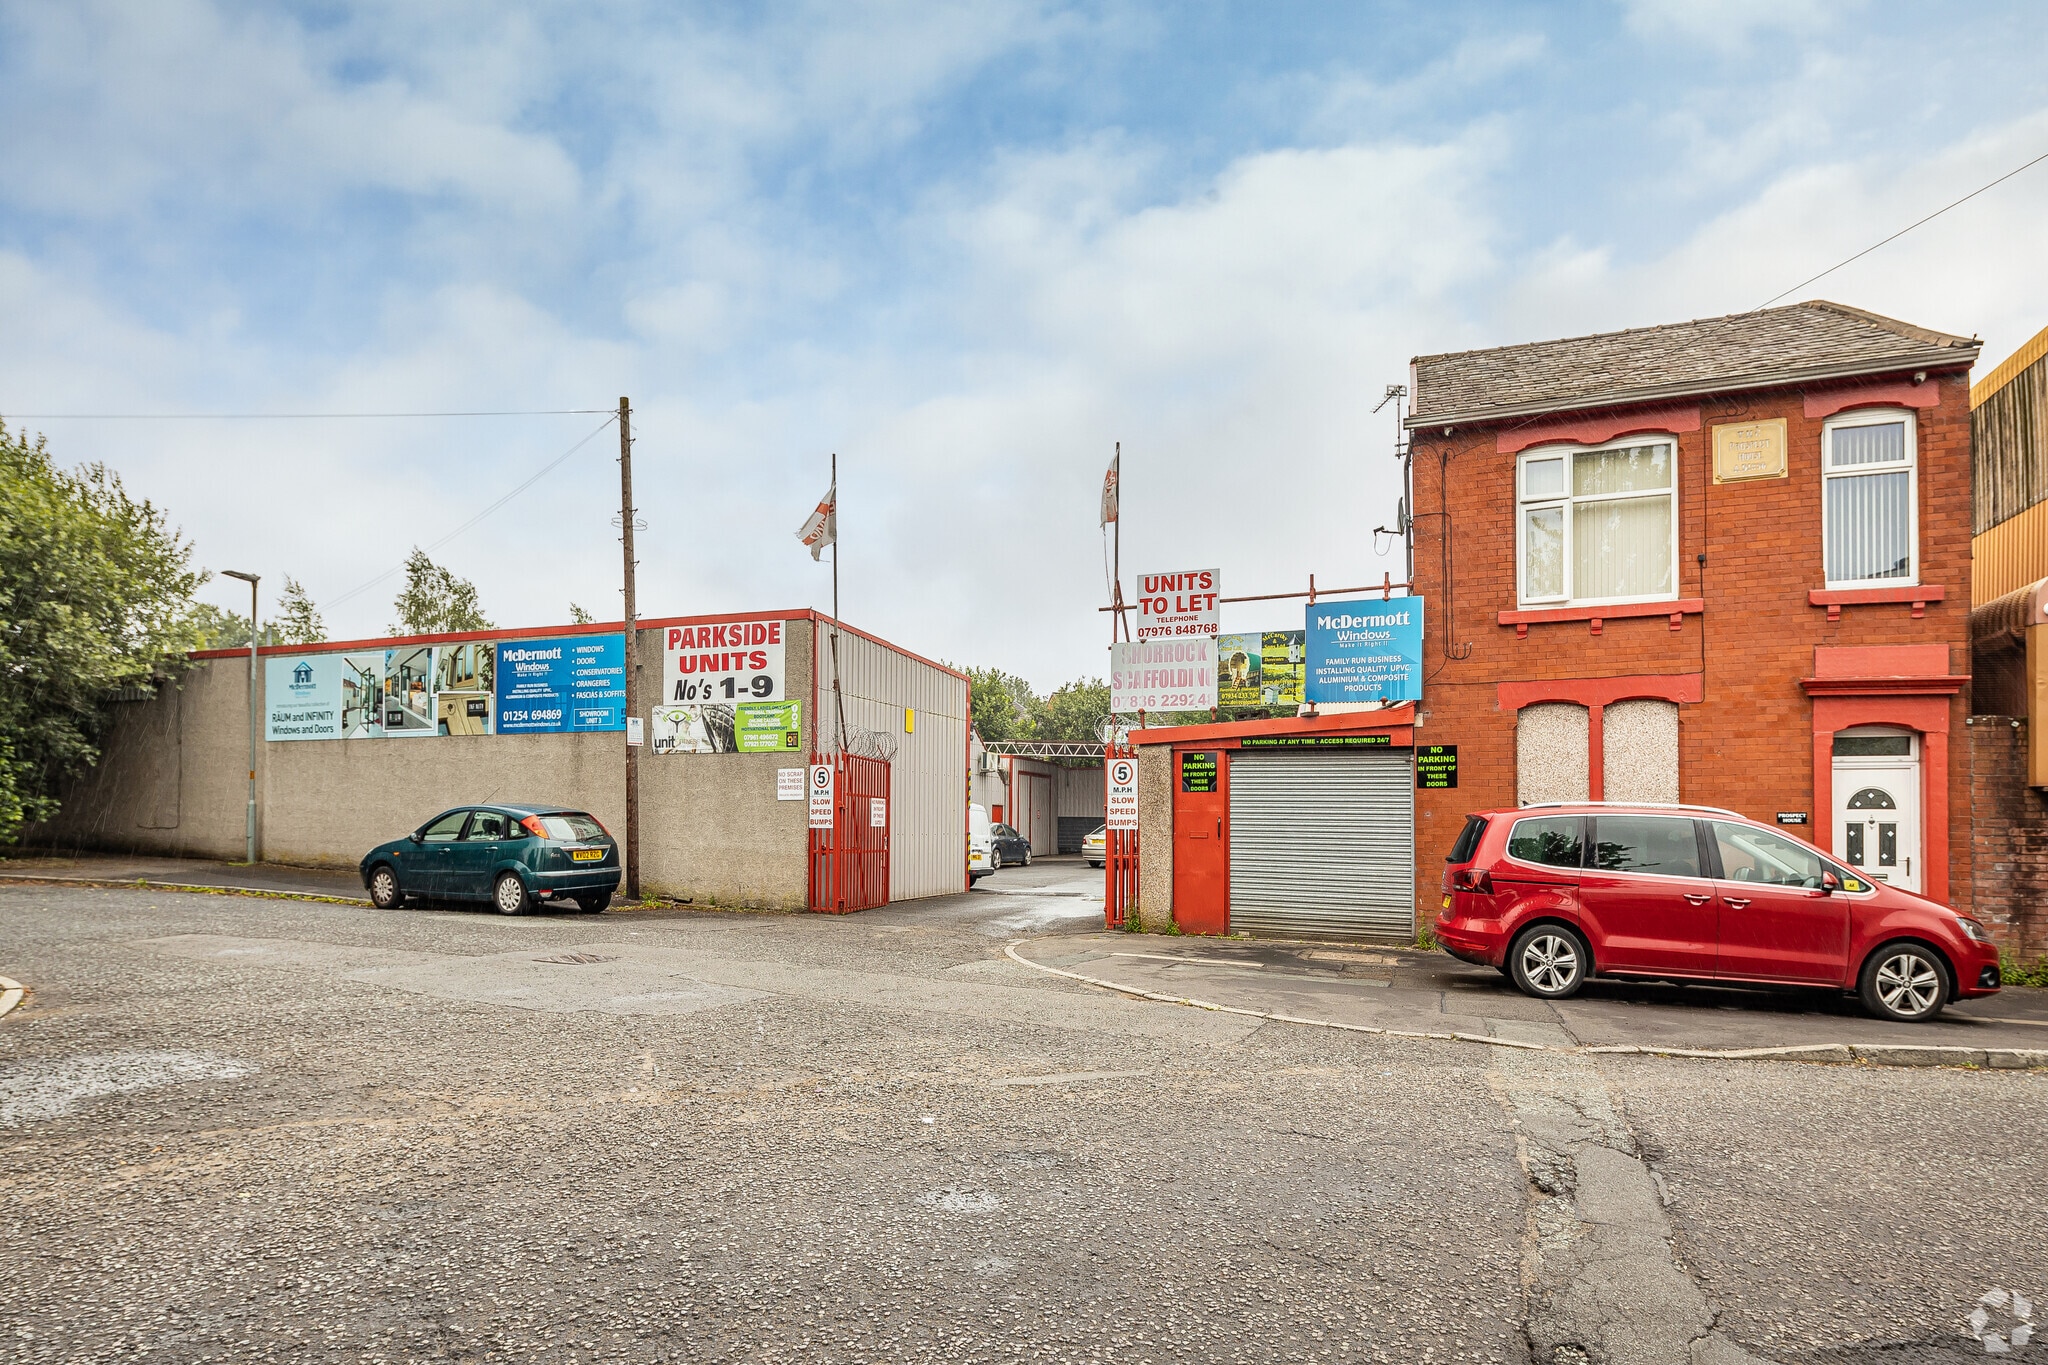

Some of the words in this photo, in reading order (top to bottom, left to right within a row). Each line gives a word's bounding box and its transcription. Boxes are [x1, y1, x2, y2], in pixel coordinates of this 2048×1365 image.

[1145, 572, 1212, 593] UNITS
[1140, 597, 1168, 615] TO
[1176, 593, 1217, 612] LET
[1156, 615, 1198, 623] TELEPHONE
[1318, 611, 1410, 630] McDermott
[668, 622, 780, 650] PARKSIDE
[1138, 626, 1172, 637] 07976
[1176, 624, 1217, 634] 848768
[1337, 630, 1390, 640] Windows
[503, 647, 562, 662] McDermott
[515, 662, 550, 671] Windows
[679, 651, 767, 674] UNITS
[576, 667, 623, 676] CONSERVATORIES
[1316, 666, 1355, 675] INSTALLING
[576, 679, 610, 687] ORANGERIES
[1319, 676, 1359, 684] ALUMINIUM
[674, 679, 712, 700] No's
[720, 675, 774, 698] 1-9
[292, 712, 304, 722] and
[305, 710, 334, 720] INFINITY
[503, 710, 528, 721] 01254
[531, 709, 562, 720] 694869
[272, 725, 300, 735] Windows
[301, 724, 313, 734] and
[315, 724, 334, 733] Doors
[654, 736, 675, 748] unit
[818, 772, 825, 784] 5
[1117, 766, 1127, 780] 5
